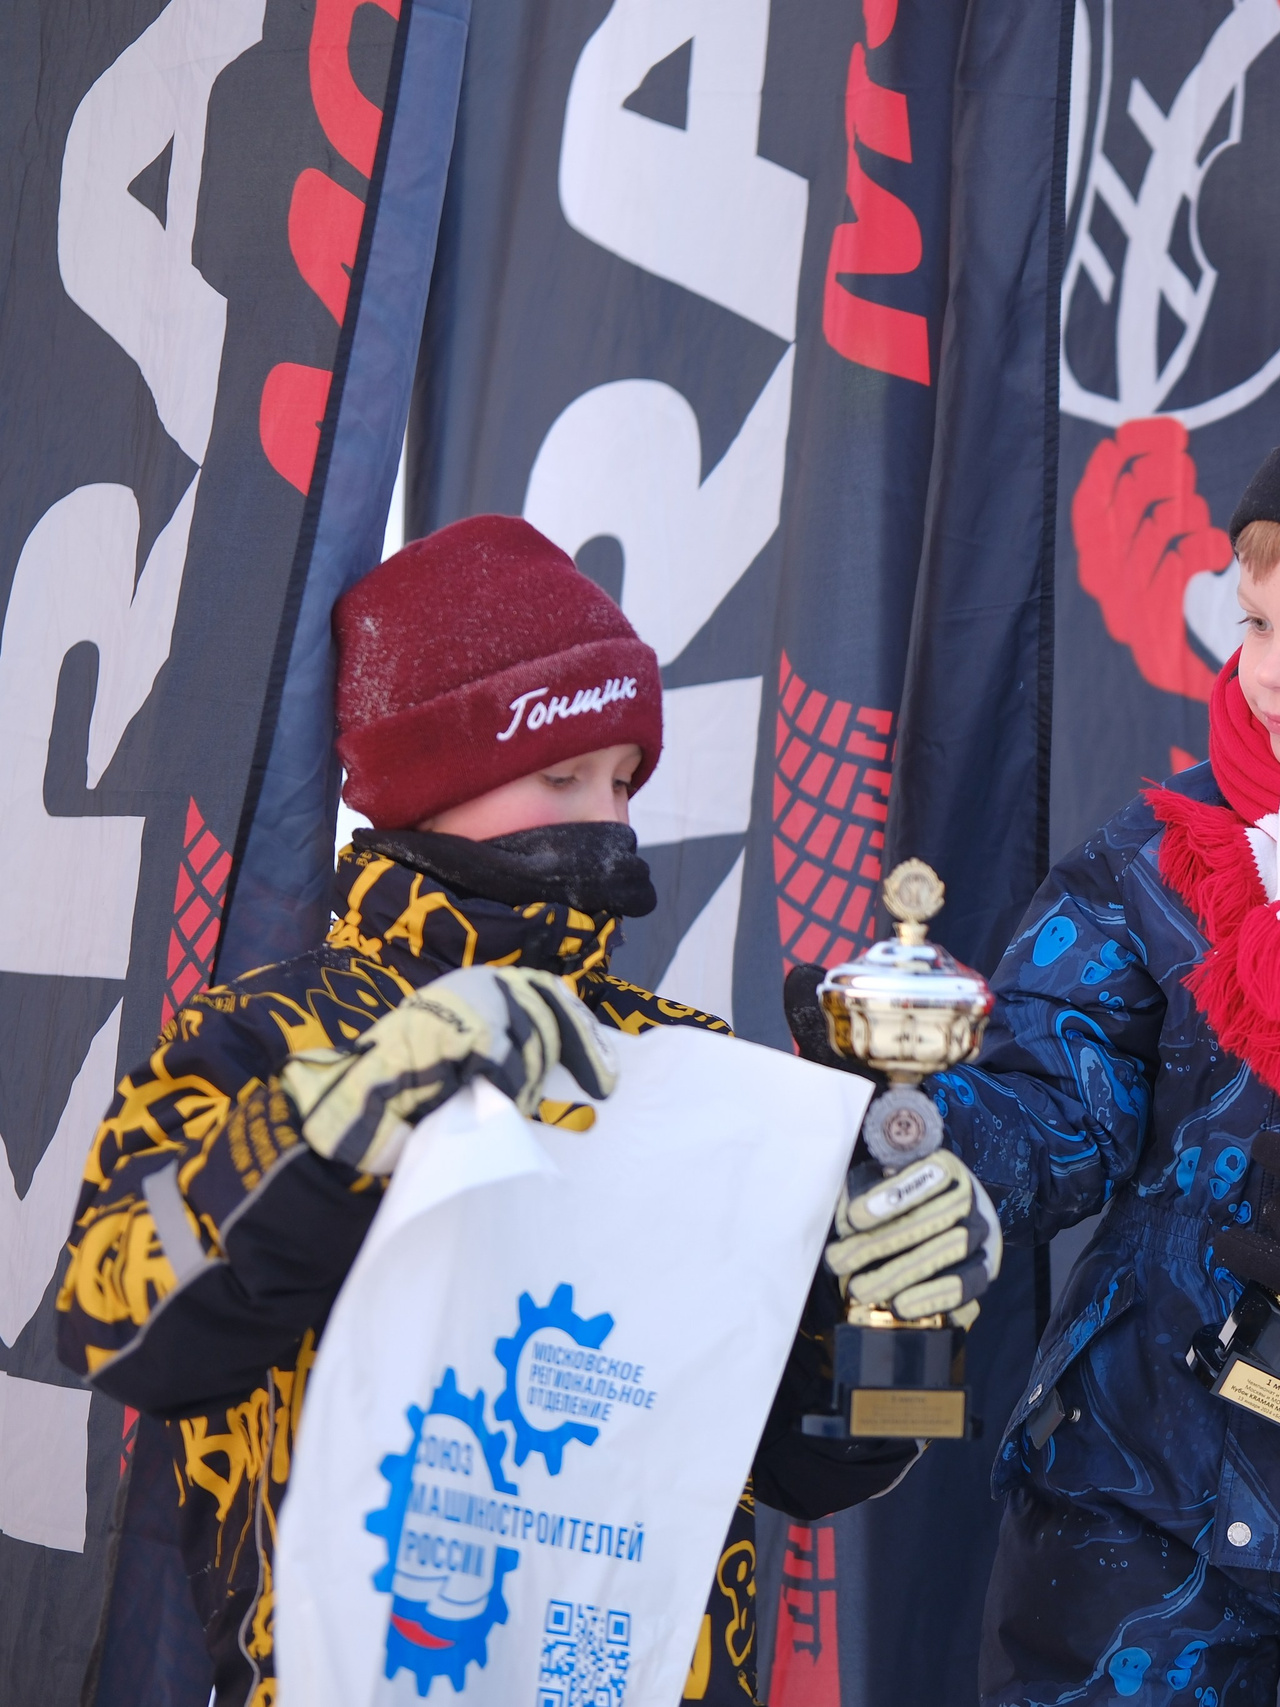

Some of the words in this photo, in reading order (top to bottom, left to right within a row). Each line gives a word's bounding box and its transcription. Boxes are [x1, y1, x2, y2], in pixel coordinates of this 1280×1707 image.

[496, 675, 638, 742] Гонщик
[533, 1341, 645, 1384] МОСКОВСКОЕ
[527, 1386, 613, 1422] ОТДЕЛЕНИЕ
[529, 1363, 658, 1409] РЕГИОНАЛЬНОЕ
[1231, 1385, 1249, 1397] Кубок
[1249, 1392, 1274, 1409] KRAMAR
[1245, 1384, 1266, 1399] Москвы
[1271, 1396, 1280, 1405] МО
[1247, 1378, 1275, 1396] Чемпионат
[410, 1482, 645, 1562] МАШИНОСТРОИТЕЛЕЙ
[404, 1529, 483, 1577] РОССИИ
